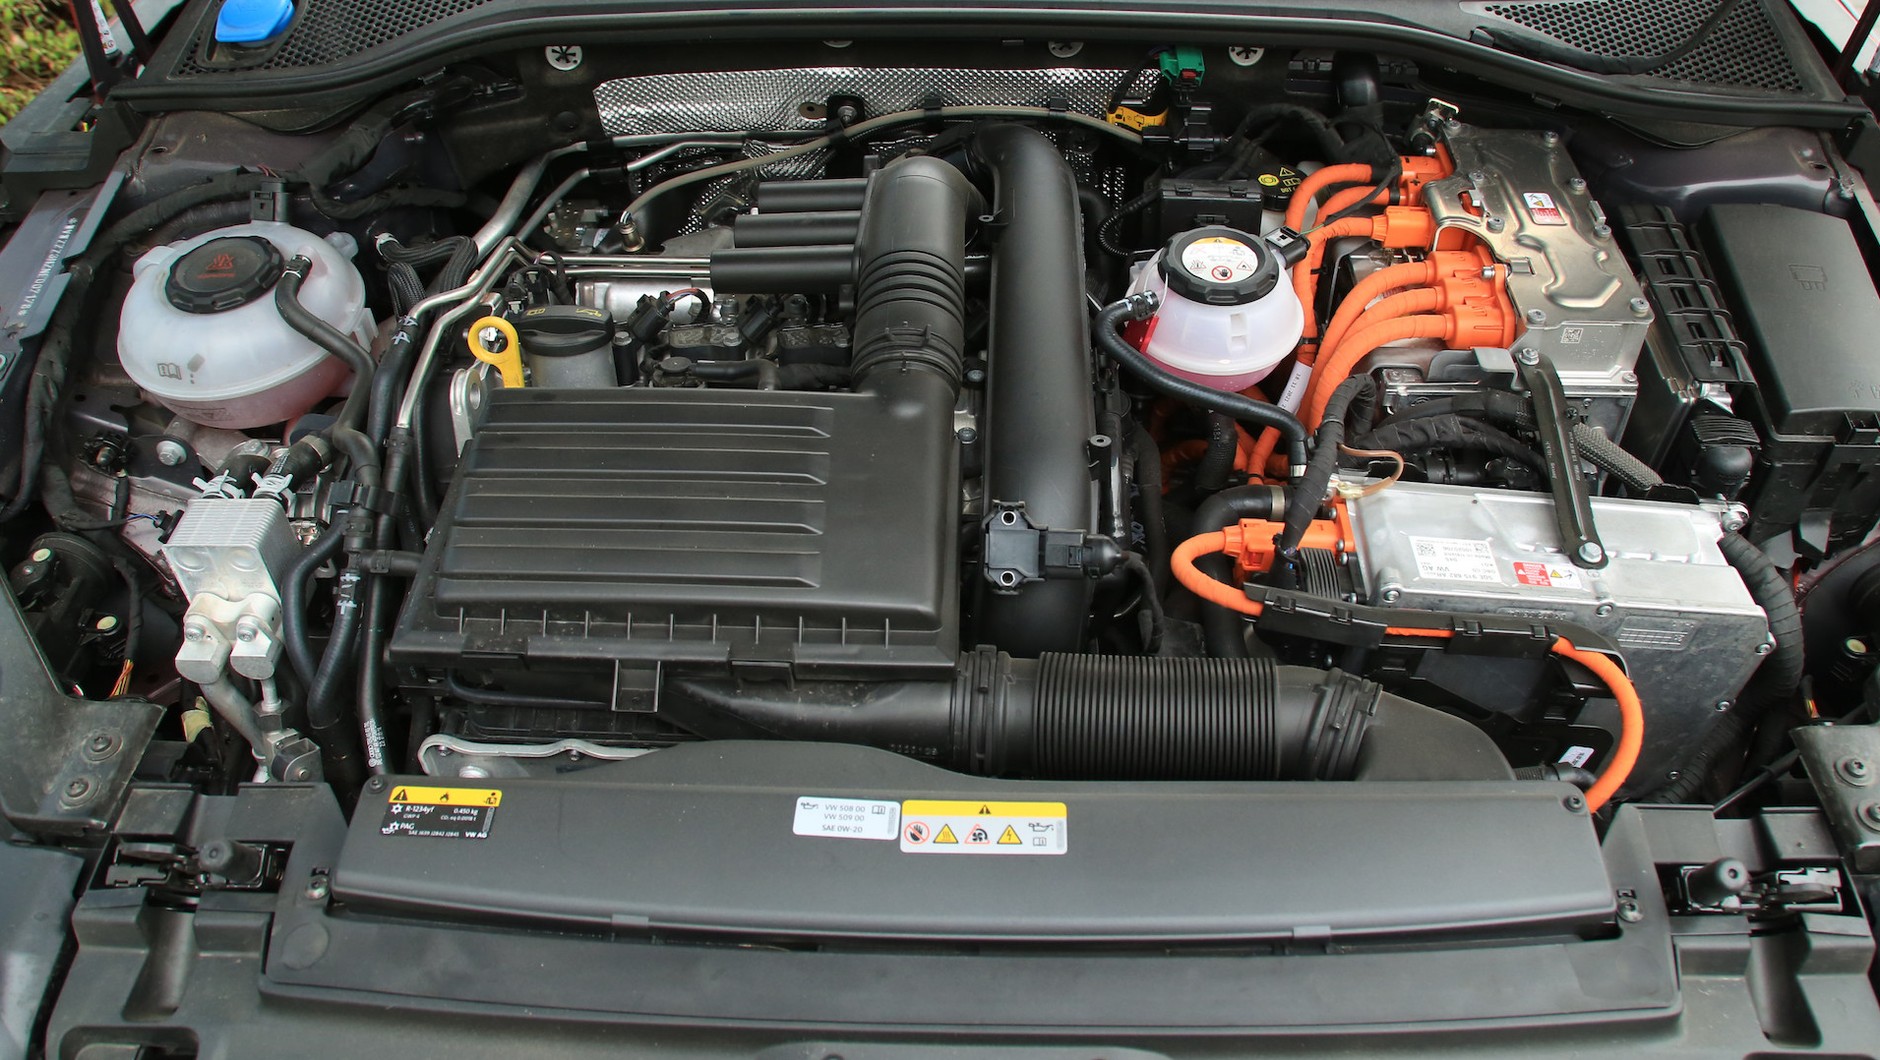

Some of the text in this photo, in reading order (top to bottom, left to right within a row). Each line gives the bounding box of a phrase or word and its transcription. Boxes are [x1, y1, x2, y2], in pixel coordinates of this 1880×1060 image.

[405, 804, 435, 814] R-1234yf
[471, 808, 479, 816] kg
[822, 824, 863, 833] SAE 0W-20
